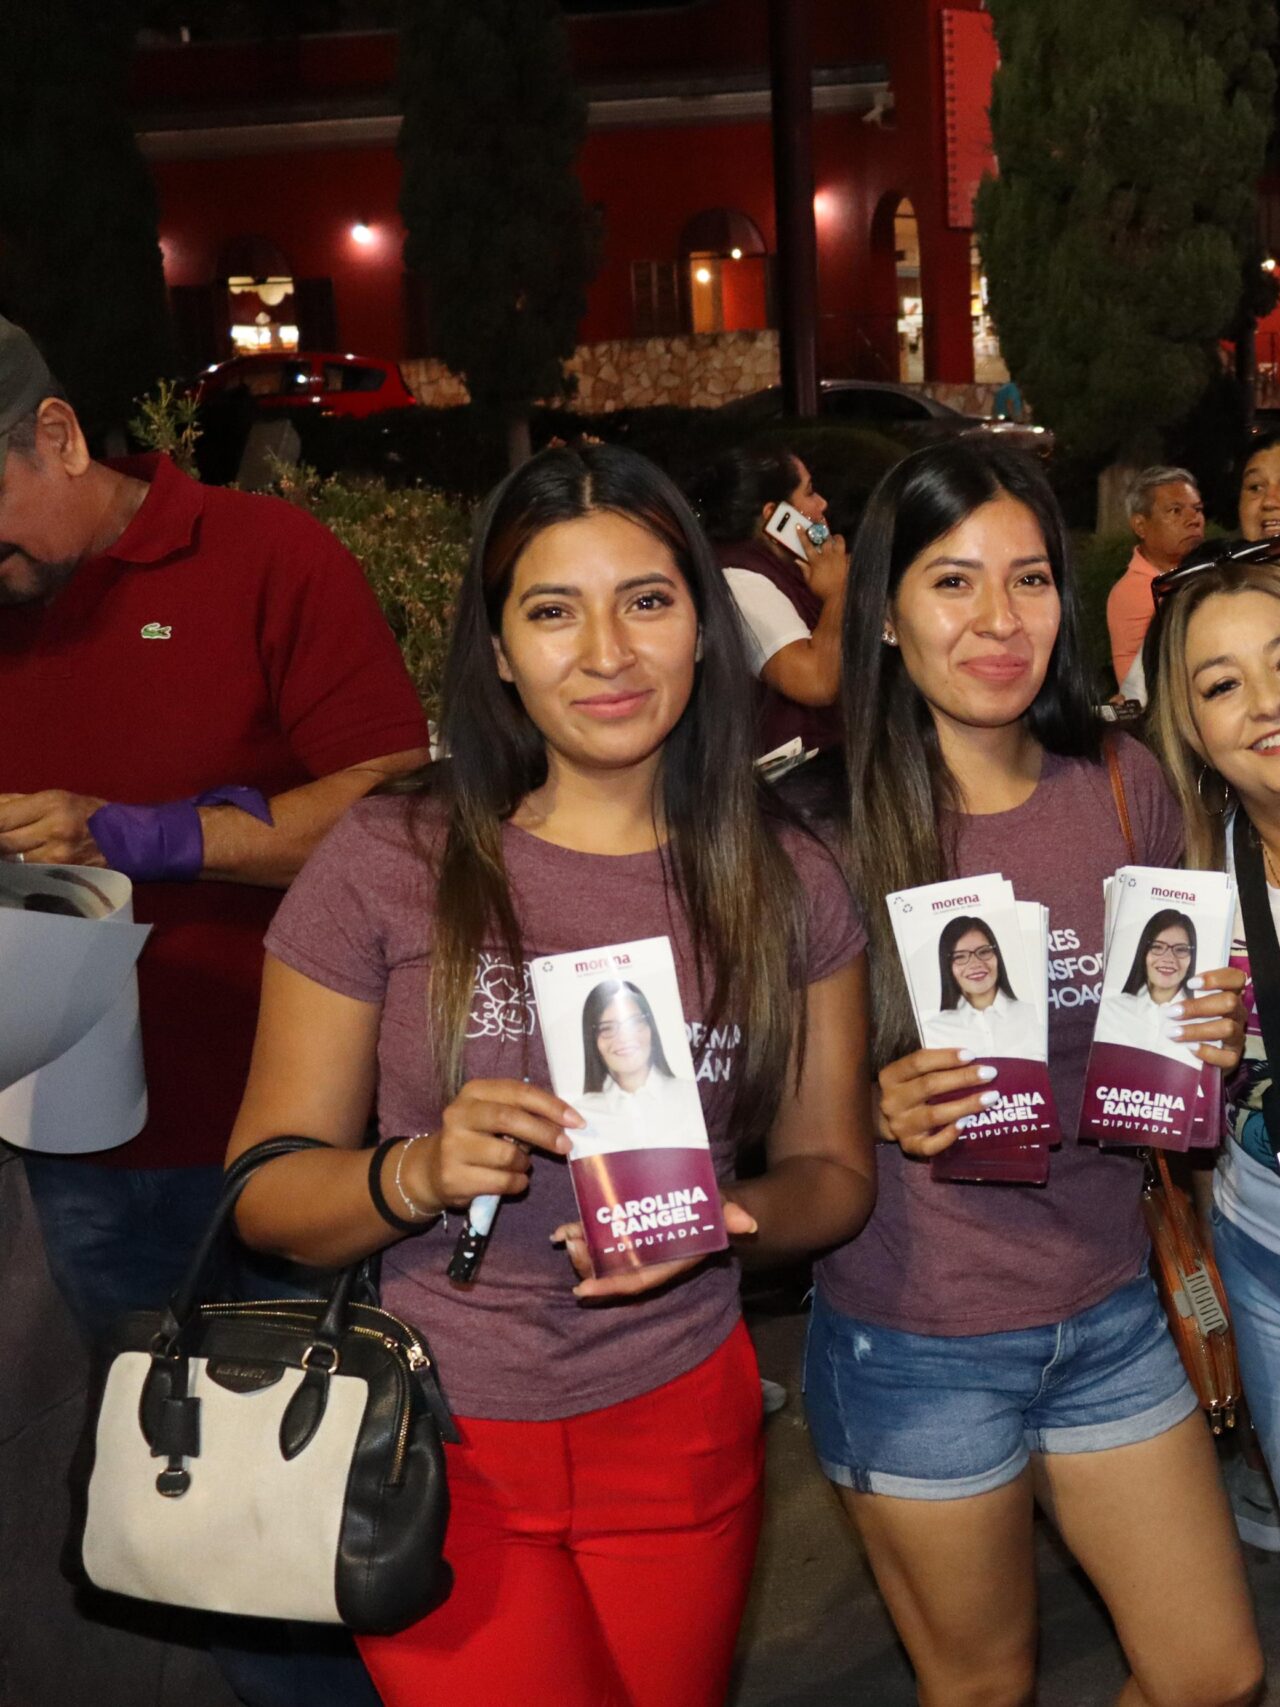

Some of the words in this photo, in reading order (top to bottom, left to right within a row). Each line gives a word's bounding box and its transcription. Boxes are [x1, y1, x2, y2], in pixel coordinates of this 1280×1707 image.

[932, 894, 980, 911] morena
[1151, 886, 1196, 902] morena
[990, 1091, 1046, 1111] OLINA
[1095, 1086, 1185, 1112] CAROLINA
[965, 1106, 1039, 1128] RANGEL
[1102, 1100, 1174, 1124] RANGEL
[970, 1124, 1038, 1140] DIPUTADA
[1102, 1119, 1168, 1135] DIPUTADA
[596, 1186, 709, 1224] CAROLINA
[610, 1206, 700, 1238] RANGEL
